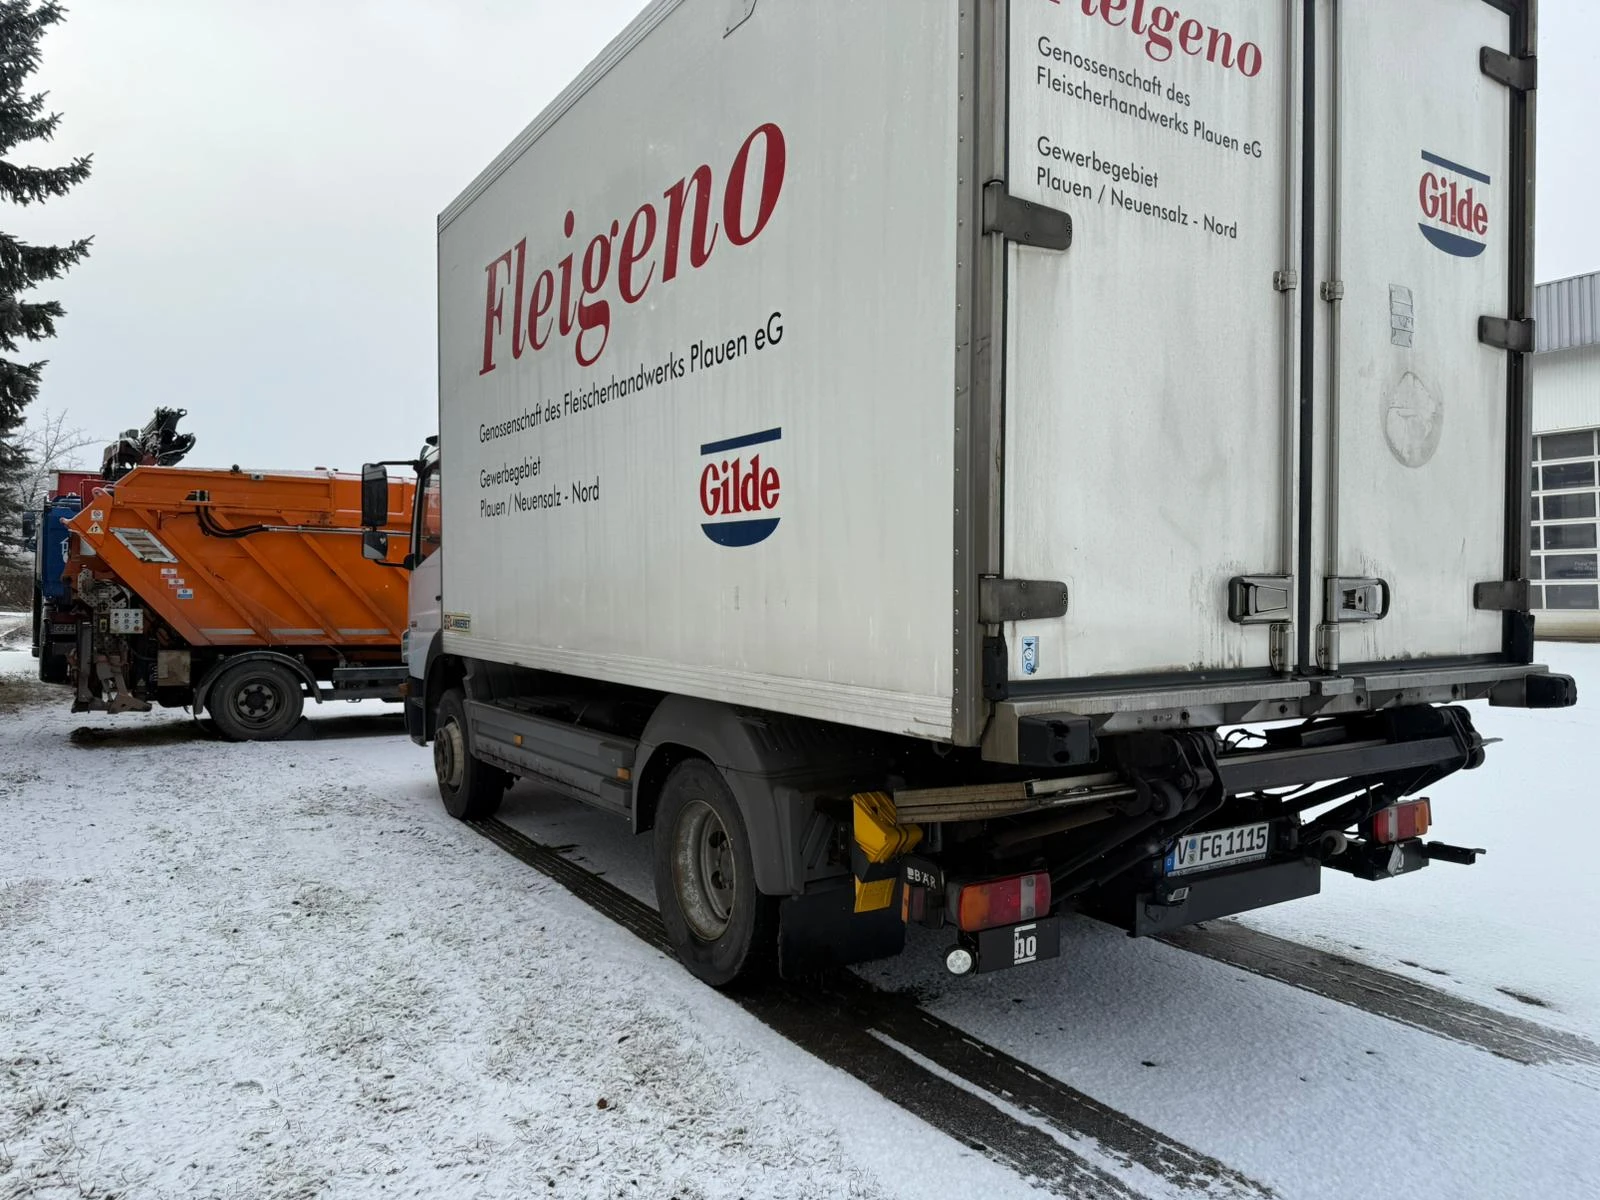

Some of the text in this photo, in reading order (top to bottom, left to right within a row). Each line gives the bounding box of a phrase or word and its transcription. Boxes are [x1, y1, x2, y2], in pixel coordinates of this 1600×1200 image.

[1037, 36, 1191, 107] Genossenschaft des
[1050, 0, 1263, 77] eigeno
[1037, 65, 1262, 159] Fleischerhandwerks Plauen eG
[1037, 136, 1159, 189] Gewerbegebiet
[1037, 166, 1092, 201] Plauen
[1111, 187, 1189, 227] Neuensalz
[1204, 214, 1238, 241] Nord
[1419, 172, 1488, 235] Gilde
[479, 122, 786, 376] Fleigeno
[479, 312, 784, 444] Genossenschaft des Fleischerhandwerks Plauen eG
[479, 456, 541, 489] Gewerbegebiet
[480, 497, 506, 518] Plauen
[514, 485, 562, 513] Neuensalz
[572, 476, 600, 505] Nord
[700, 453, 781, 517] Gilde
[1178, 839, 1189, 865] V
